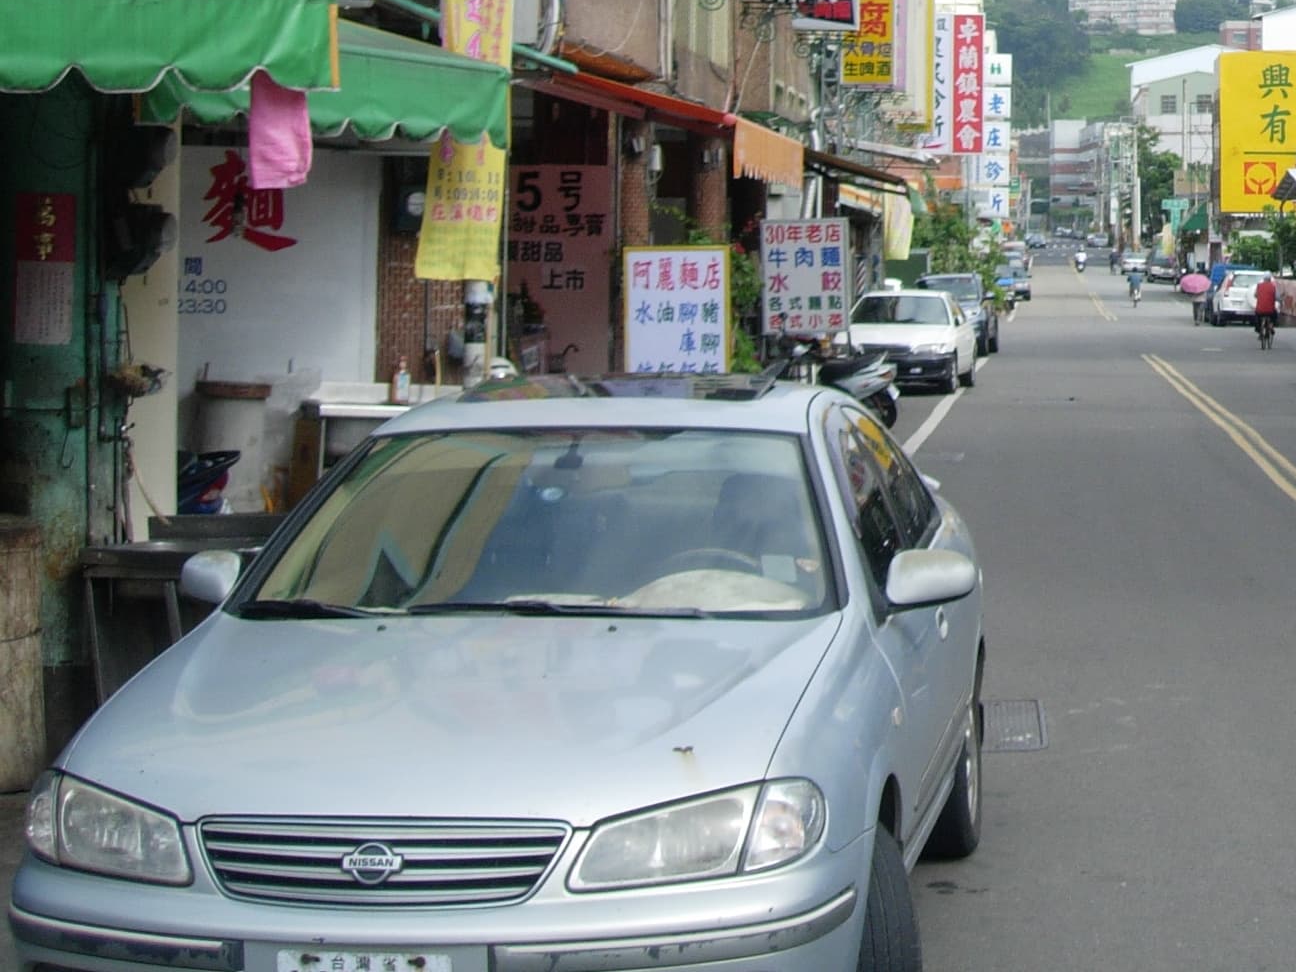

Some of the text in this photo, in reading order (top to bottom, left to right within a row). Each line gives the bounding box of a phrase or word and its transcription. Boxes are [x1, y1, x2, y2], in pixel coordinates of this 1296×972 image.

[956, 17, 982, 151] 卓蘭鎮農會
[765, 224, 841, 245] 30年老店
[768, 246, 841, 268] 牛肉麵
[348, 857, 394, 867] NISSAN
